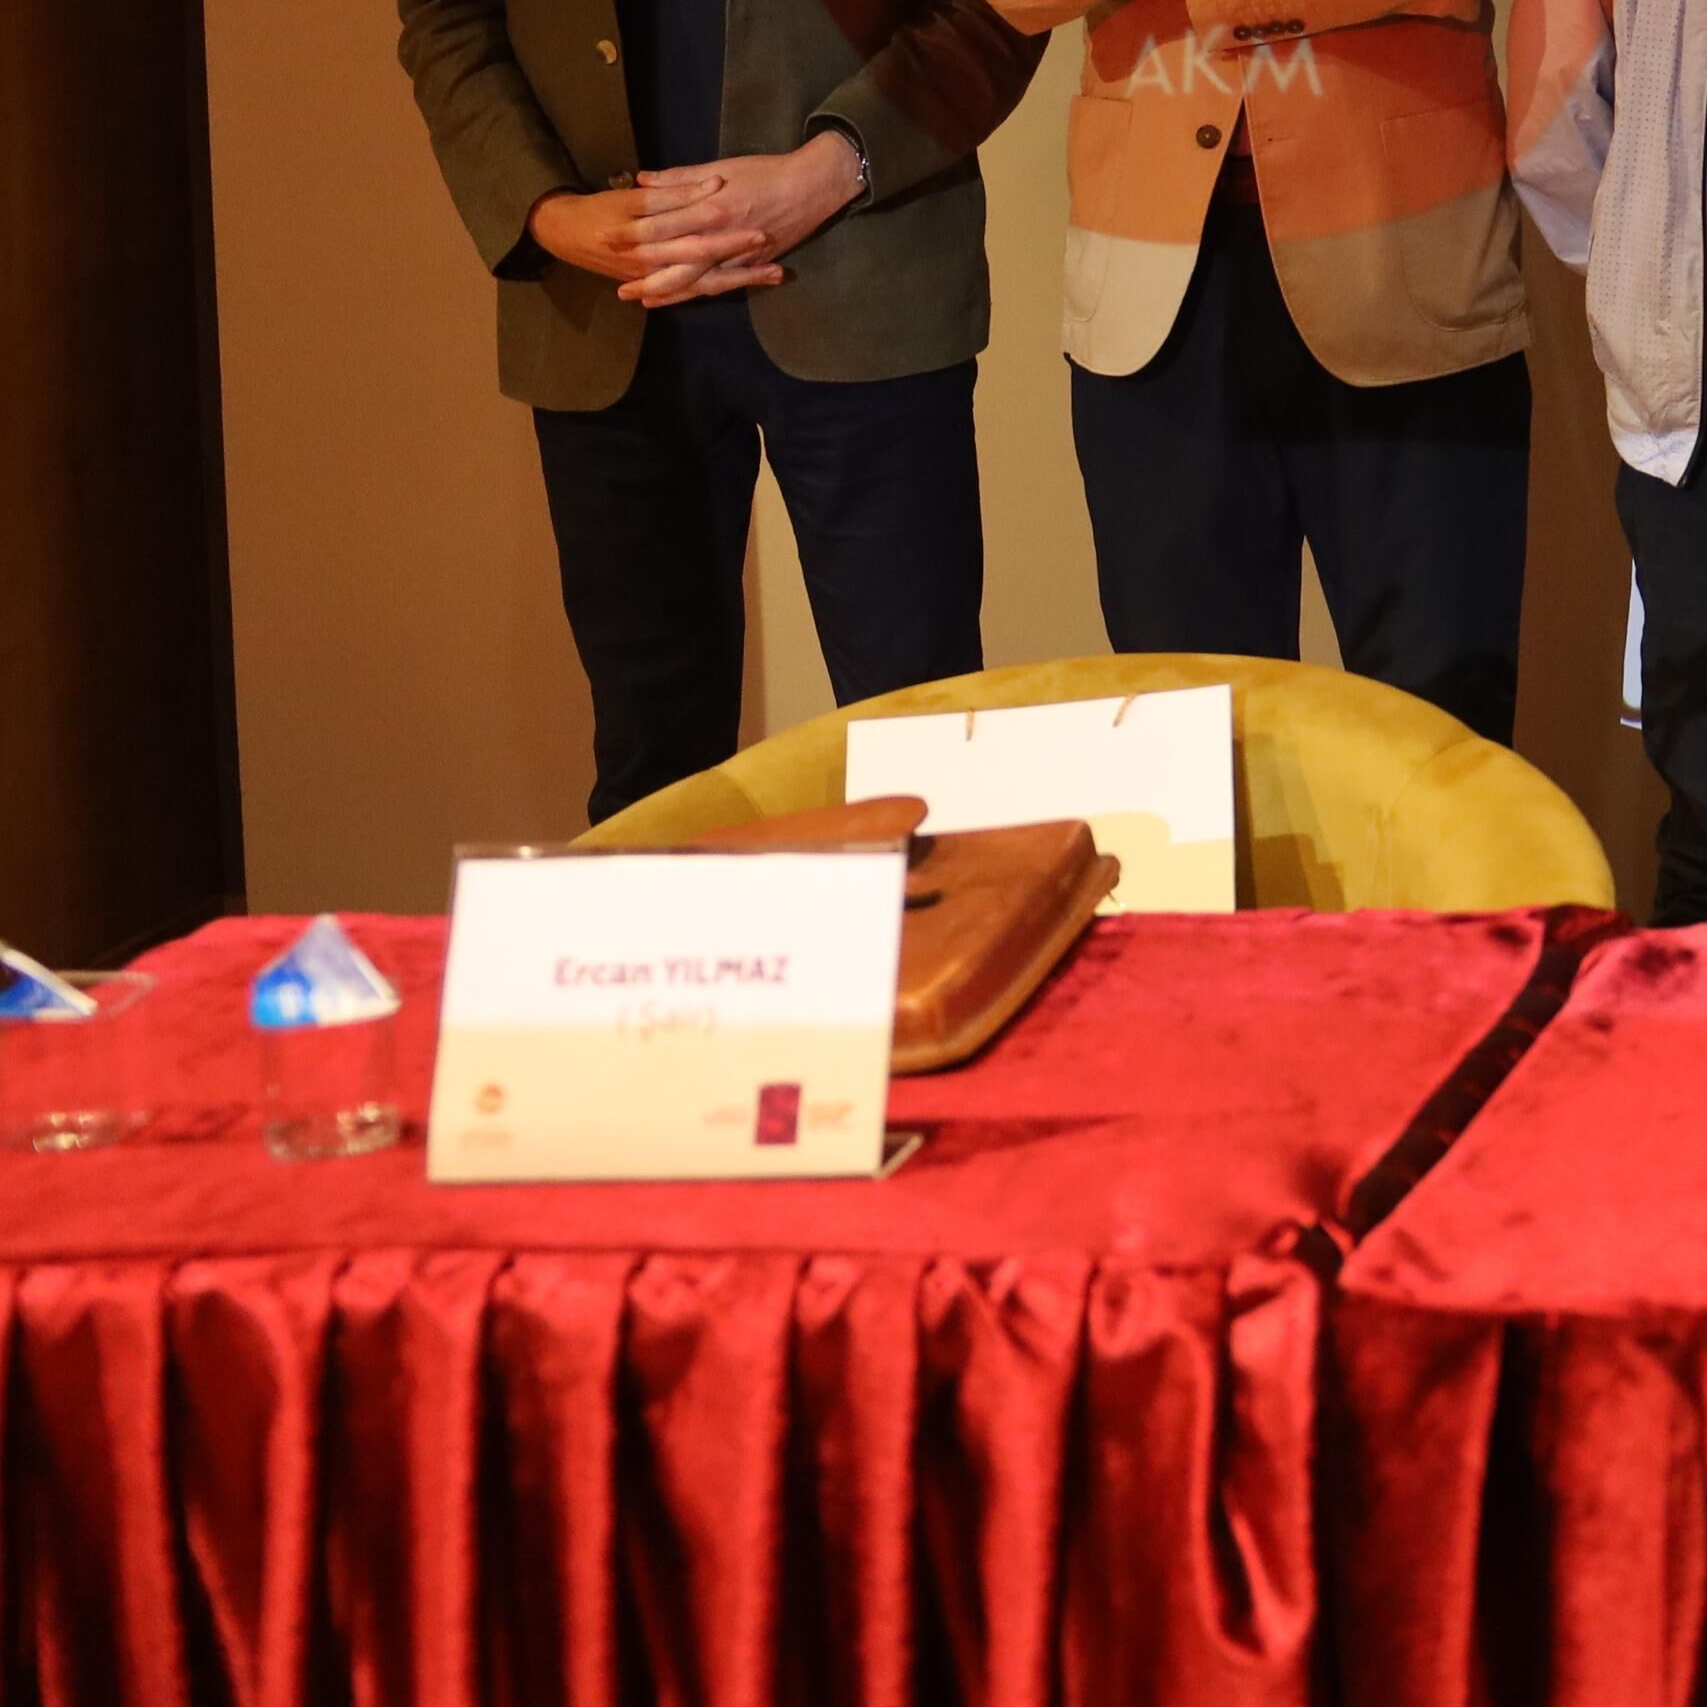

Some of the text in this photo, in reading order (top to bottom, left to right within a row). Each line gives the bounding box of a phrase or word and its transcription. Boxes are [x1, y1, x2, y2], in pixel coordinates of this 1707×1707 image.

[1125, 20, 1325, 97] AKM
[555, 954, 791, 988] Ercan YILMAZ
